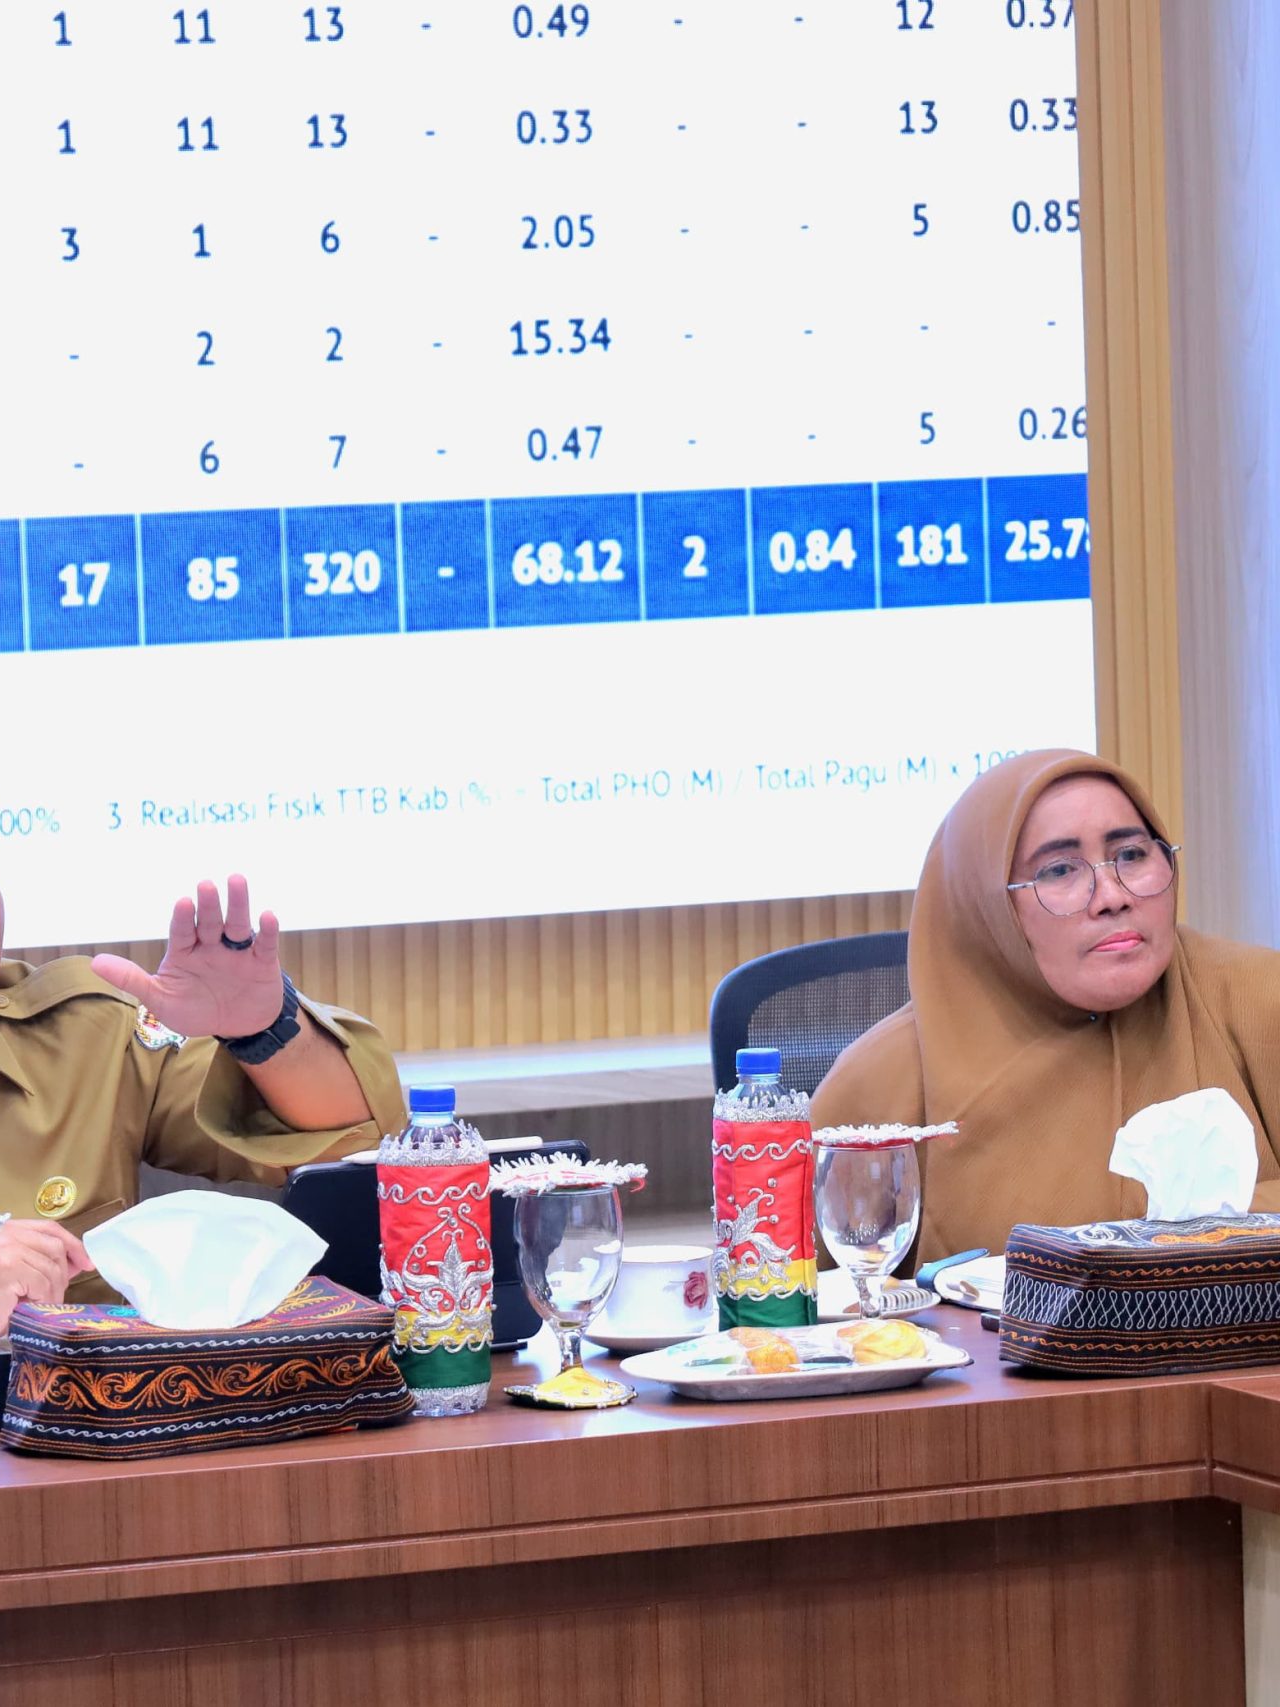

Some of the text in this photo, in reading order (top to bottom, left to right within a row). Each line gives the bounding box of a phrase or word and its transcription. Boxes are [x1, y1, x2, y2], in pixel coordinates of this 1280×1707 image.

[52, 10, 73, 47] 1
[172, 8, 217, 45] 11
[302, 5, 345, 43] 13
[512, 2, 590, 39] 0.49
[895, 0, 935, 32] 12
[56, 118, 77, 155] 1
[176, 115, 220, 153] 11
[306, 113, 348, 150] 13
[515, 108, 593, 146] 0.33
[898, 99, 939, 135] 13
[1009, 96, 1078, 132] 0.33
[60, 226, 81, 263] 3
[191, 222, 212, 259] 1
[319, 220, 341, 255] 6
[521, 213, 596, 251] 2.05
[912, 202, 930, 238] 5
[1011, 199, 1081, 234] 0.85
[196, 330, 216, 367] 2
[325, 326, 344, 363] 2
[509, 317, 613, 357] 15.34
[199, 439, 221, 475] 6
[328, 434, 347, 470] 7
[526, 424, 604, 463] 0.47
[919, 411, 937, 446] 5
[1018, 406, 1087, 441] 0.26
[58, 562, 111, 607] 17
[187, 556, 240, 601] 85
[303, 550, 381, 596] 320
[512, 539, 624, 586] 68.12
[683, 535, 707, 577] 2
[769, 528, 856, 573] 0.84
[896, 523, 968, 567] 181
[1003, 517, 1091, 562] 25.7
[140, 799, 257, 829] Realisasi
[266, 791, 326, 821] Fisik
[335, 785, 389, 816] TTB
[397, 784, 449, 813] Kab
[540, 775, 603, 805] Total
[612, 768, 672, 799] PHO
[682, 766, 724, 800] (M)
[754, 762, 817, 791] Total
[824, 759, 888, 794] Pagu
[896, 755, 937, 785] (M)
